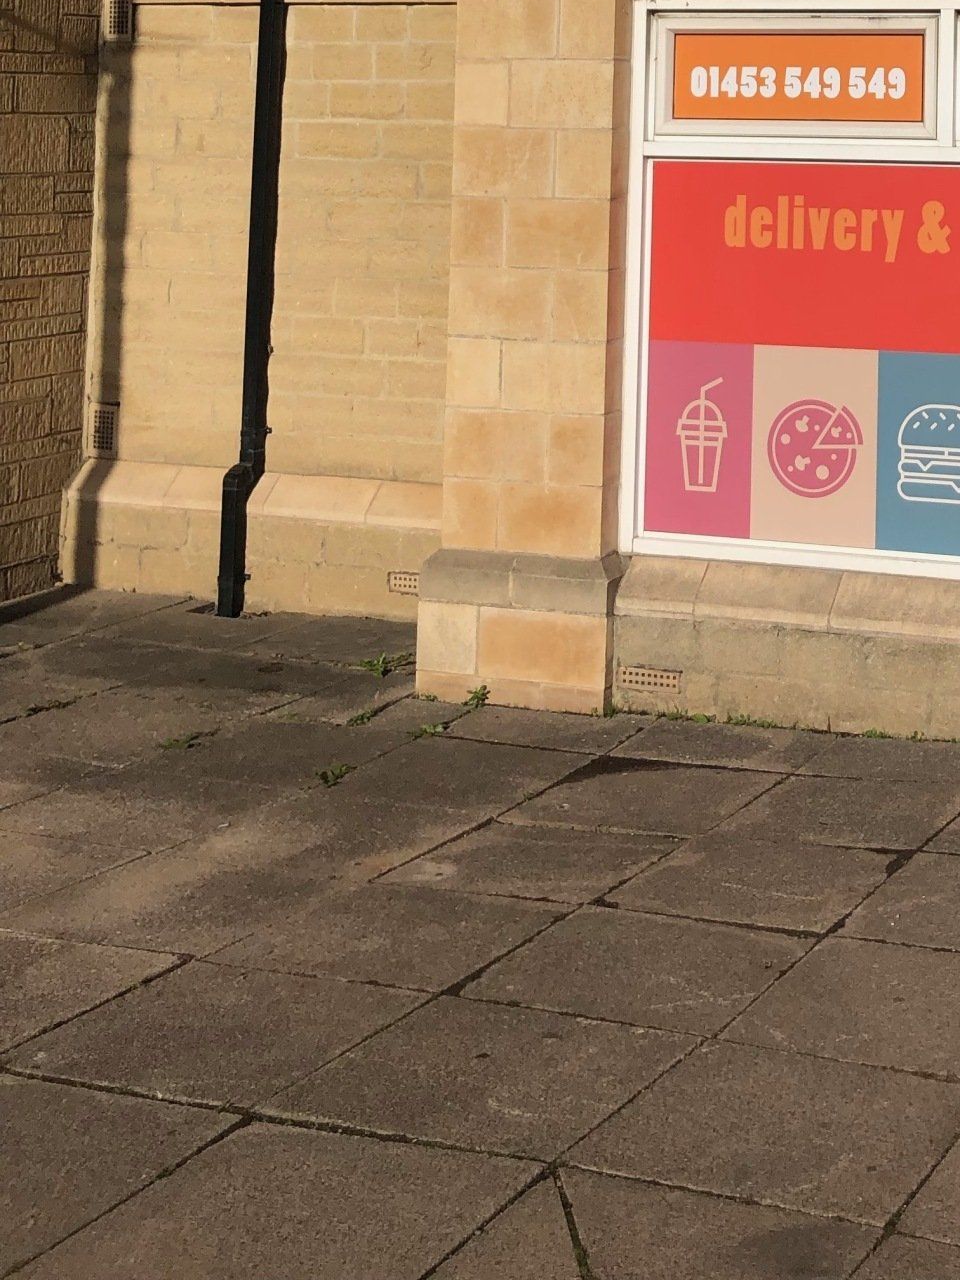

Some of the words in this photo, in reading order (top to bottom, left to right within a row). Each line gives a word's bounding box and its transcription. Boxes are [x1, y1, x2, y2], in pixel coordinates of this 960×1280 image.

[690, 66, 777, 98] 01453
[783, 67, 841, 99] 549
[847, 67, 907, 100] 549
[724, 195, 905, 264] delivery
[917, 200, 952, 254] &
